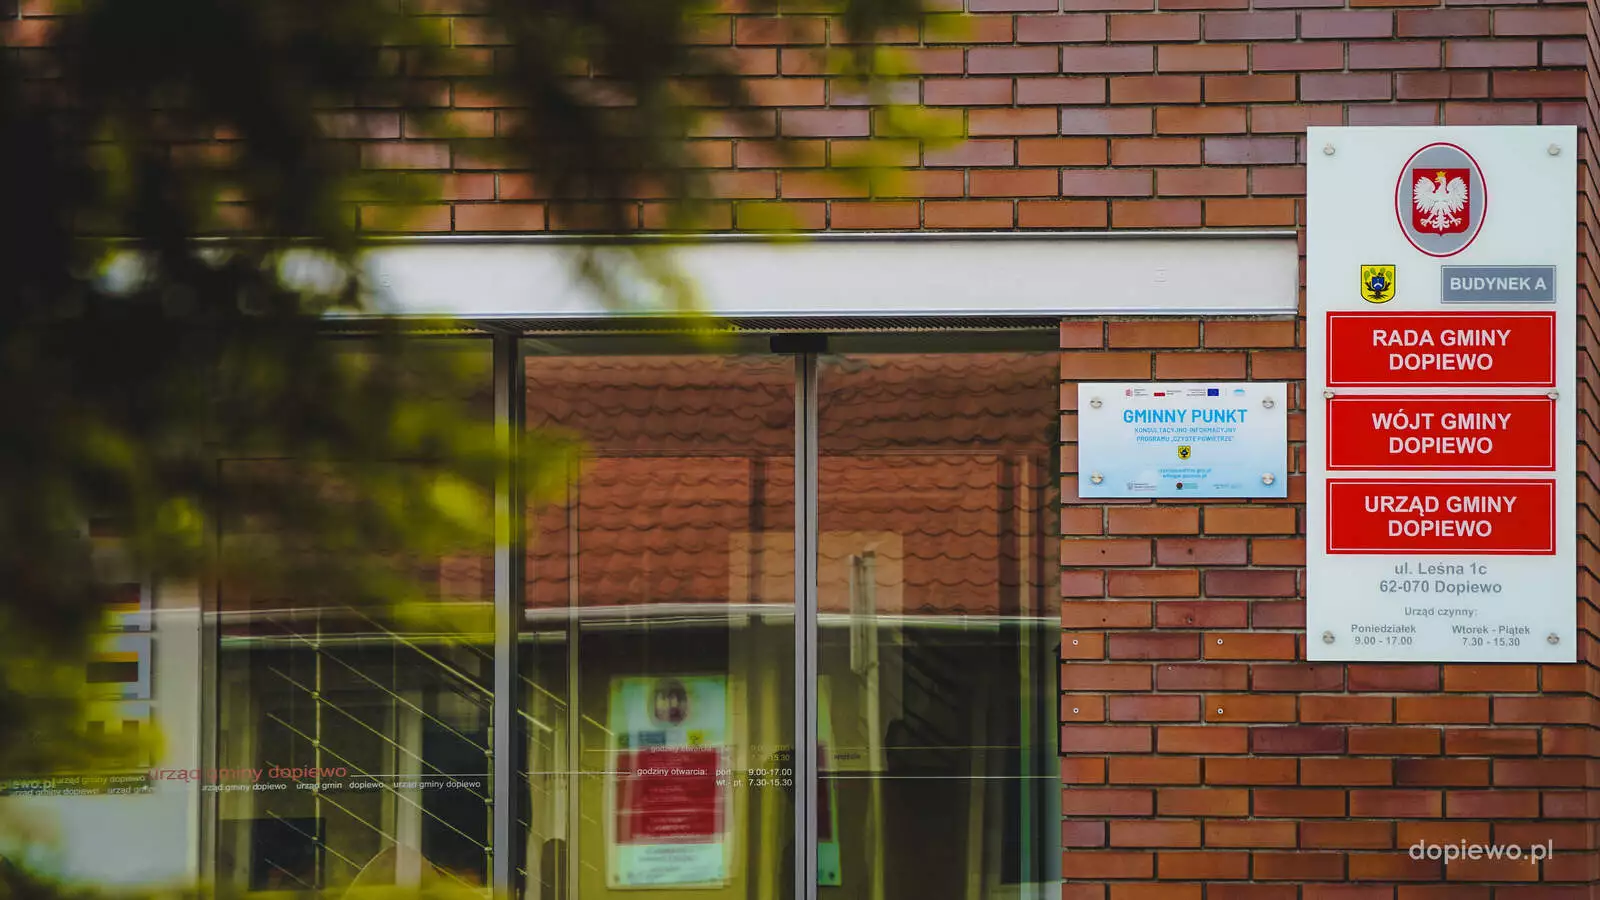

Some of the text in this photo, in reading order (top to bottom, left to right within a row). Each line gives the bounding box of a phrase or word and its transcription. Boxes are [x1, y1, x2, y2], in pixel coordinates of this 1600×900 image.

[1450, 277, 1547, 291] BUDYNEK A
[1372, 329, 1511, 346] RADA GMINY
[1389, 353, 1493, 370] DOPIEWO
[1123, 409, 1248, 424] GMINNY PUNKT
[1372, 409, 1512, 430] WÓJT GMINY
[1389, 437, 1493, 454] DOPIEWO
[1364, 495, 1517, 516] URZĄD GMINY
[1388, 519, 1493, 537] DOPIEWO
[1394, 562, 1488, 575] ul. Leśna 1c
[1379, 580, 1503, 596] 62-070 Dopiewo
[1404, 606, 1478, 618] Urząd czynny:
[1351, 624, 1417, 634] Poniedziałek
[1452, 625, 1489, 635] Wtorek
[1498, 625, 1531, 636] Piątek
[1354, 636, 1376, 646] 9.00
[1386, 636, 1413, 646] 17.00
[1462, 637, 1484, 646] 7.30
[1494, 637, 1521, 646] 15.30
[268, 763, 347, 781] dopiewo
[636, 767, 669, 777] godziny
[670, 767, 708, 776] otwarcia:
[748, 767, 793, 777] 9.00-17.00
[251, 782, 287, 792] dopiewo
[349, 781, 384, 791] dopiewo
[446, 779, 481, 790] dopiewo
[748, 778, 793, 787] 7.30-15.30
